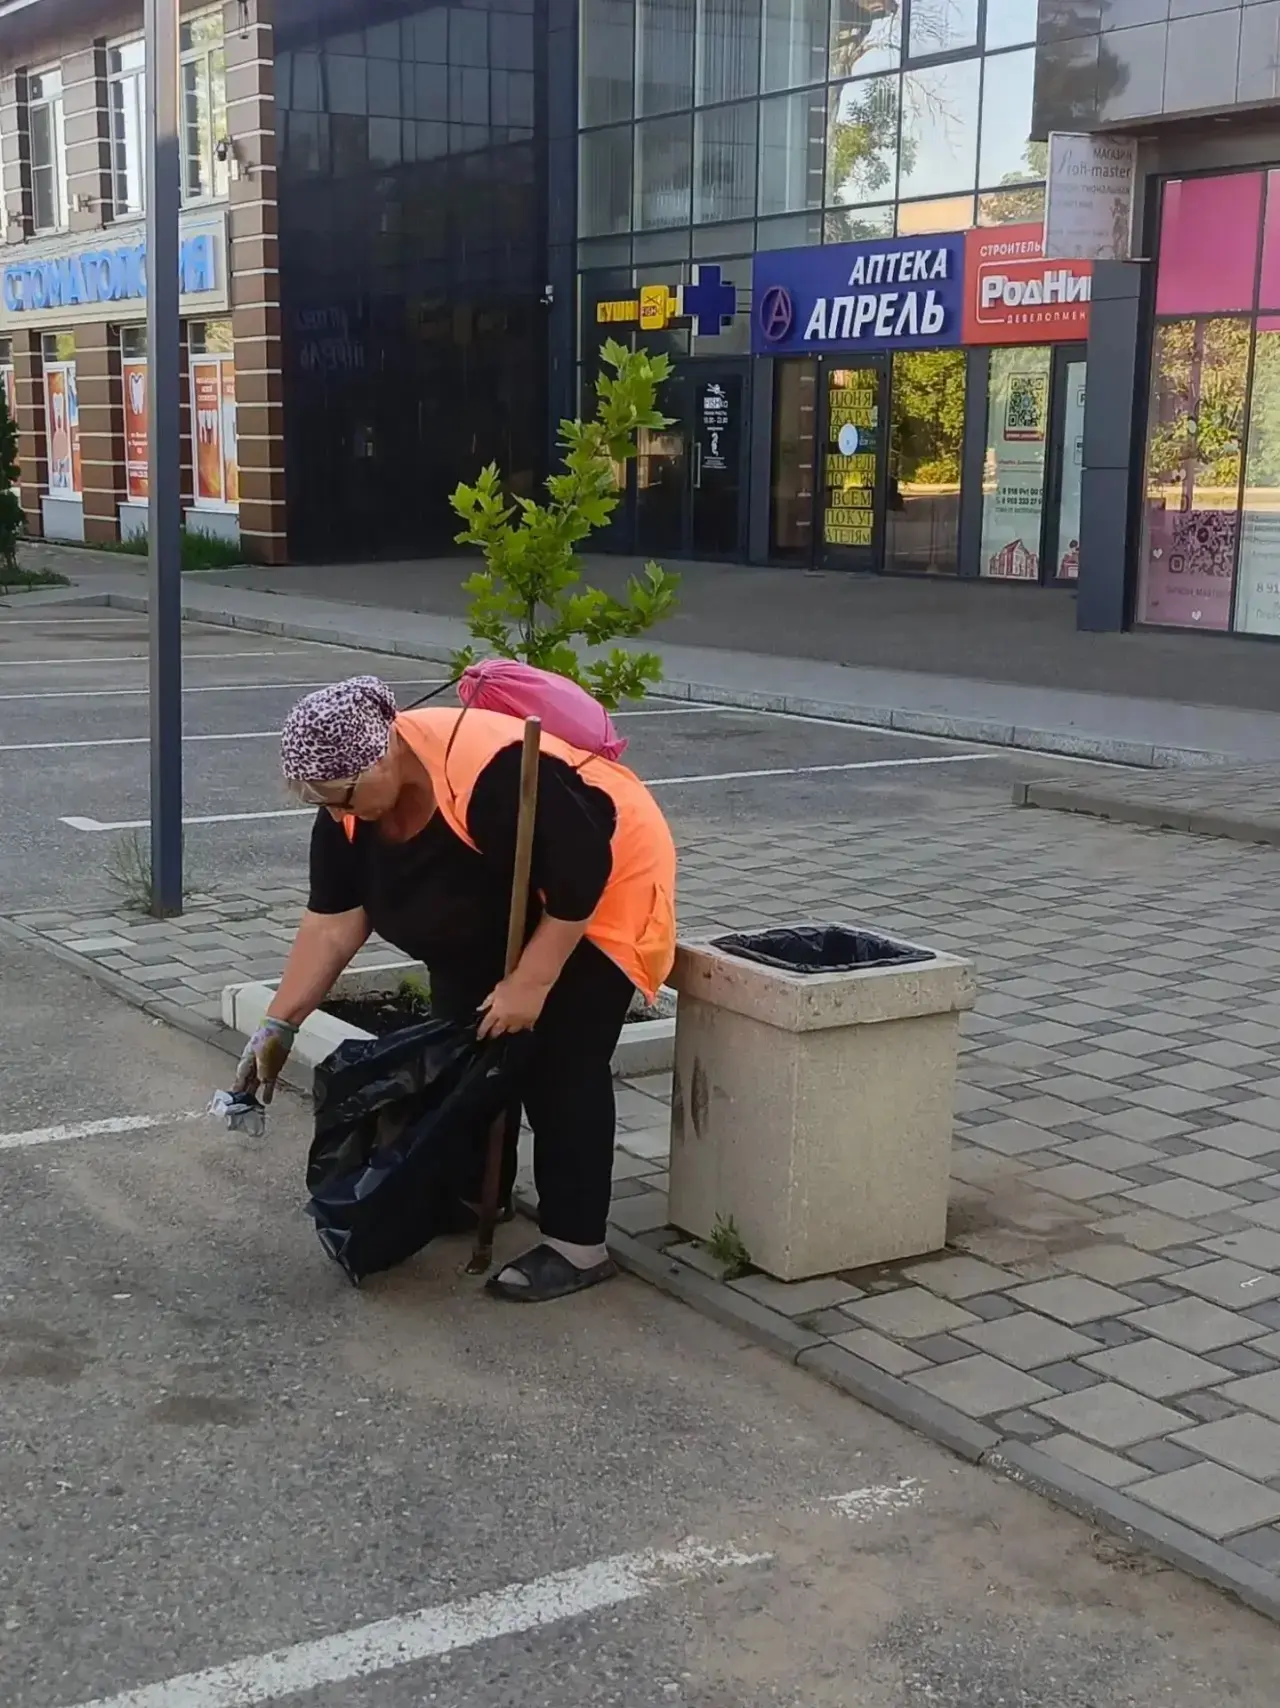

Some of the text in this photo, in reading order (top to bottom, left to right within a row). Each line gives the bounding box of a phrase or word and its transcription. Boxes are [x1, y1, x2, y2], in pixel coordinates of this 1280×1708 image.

[980, 240, 1042, 257] СТРОИТЕЛЬ
[848, 248, 947, 286] АПТЕКА
[597, 300, 639, 322] СУШИ
[804, 289, 946, 340] АПРЕЛЬ
[1007, 311, 1086, 324] ДЕВЕЛОПМЕН
[831, 391, 871, 406] ИЮНЯ
[832, 410, 871, 427] ЖАРА
[833, 491, 871, 506] ВСЕМ
